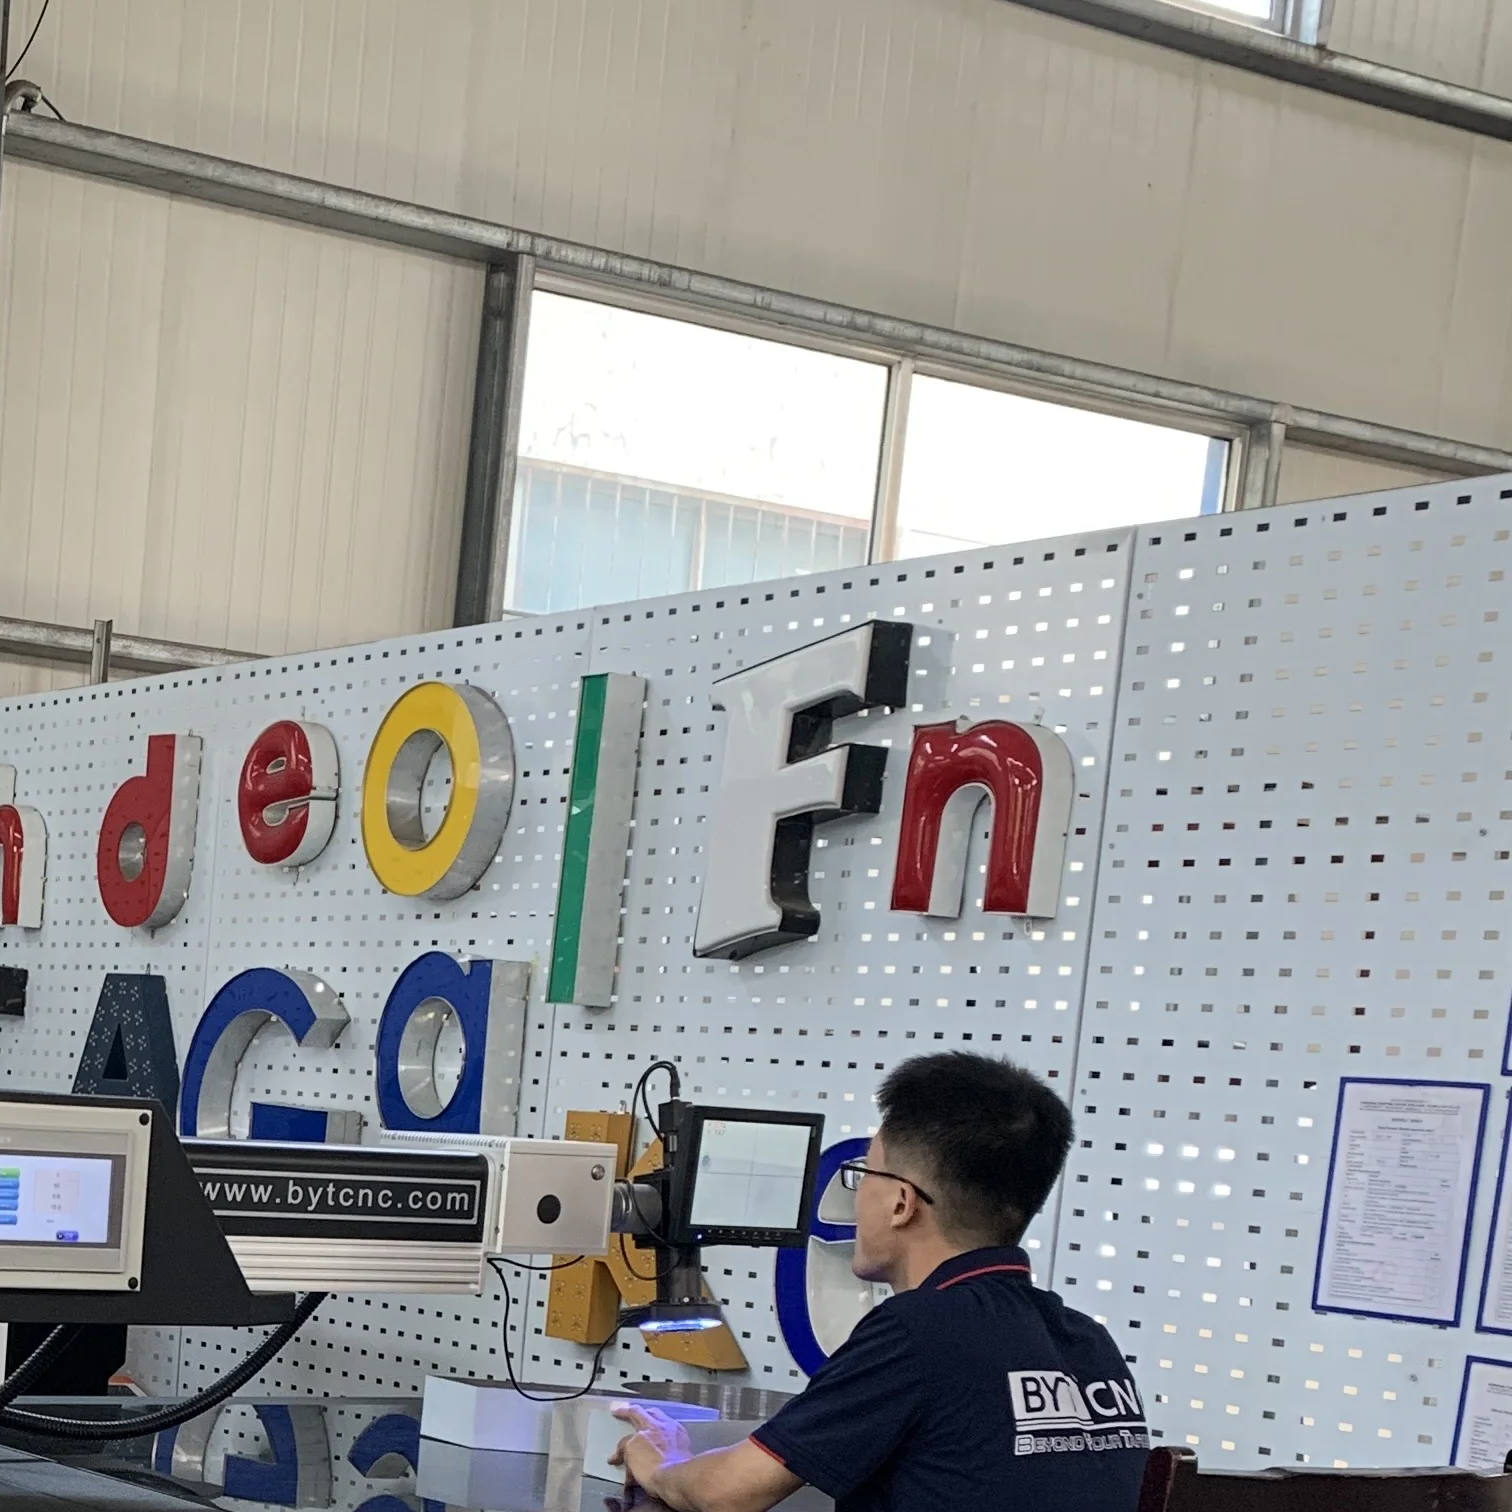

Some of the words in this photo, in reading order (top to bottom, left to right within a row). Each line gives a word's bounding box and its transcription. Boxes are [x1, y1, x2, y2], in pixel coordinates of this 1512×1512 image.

[97, 734, 194, 928] d
[238, 720, 331, 867] e
[199, 1179, 470, 1212] www.bytcnc.com
